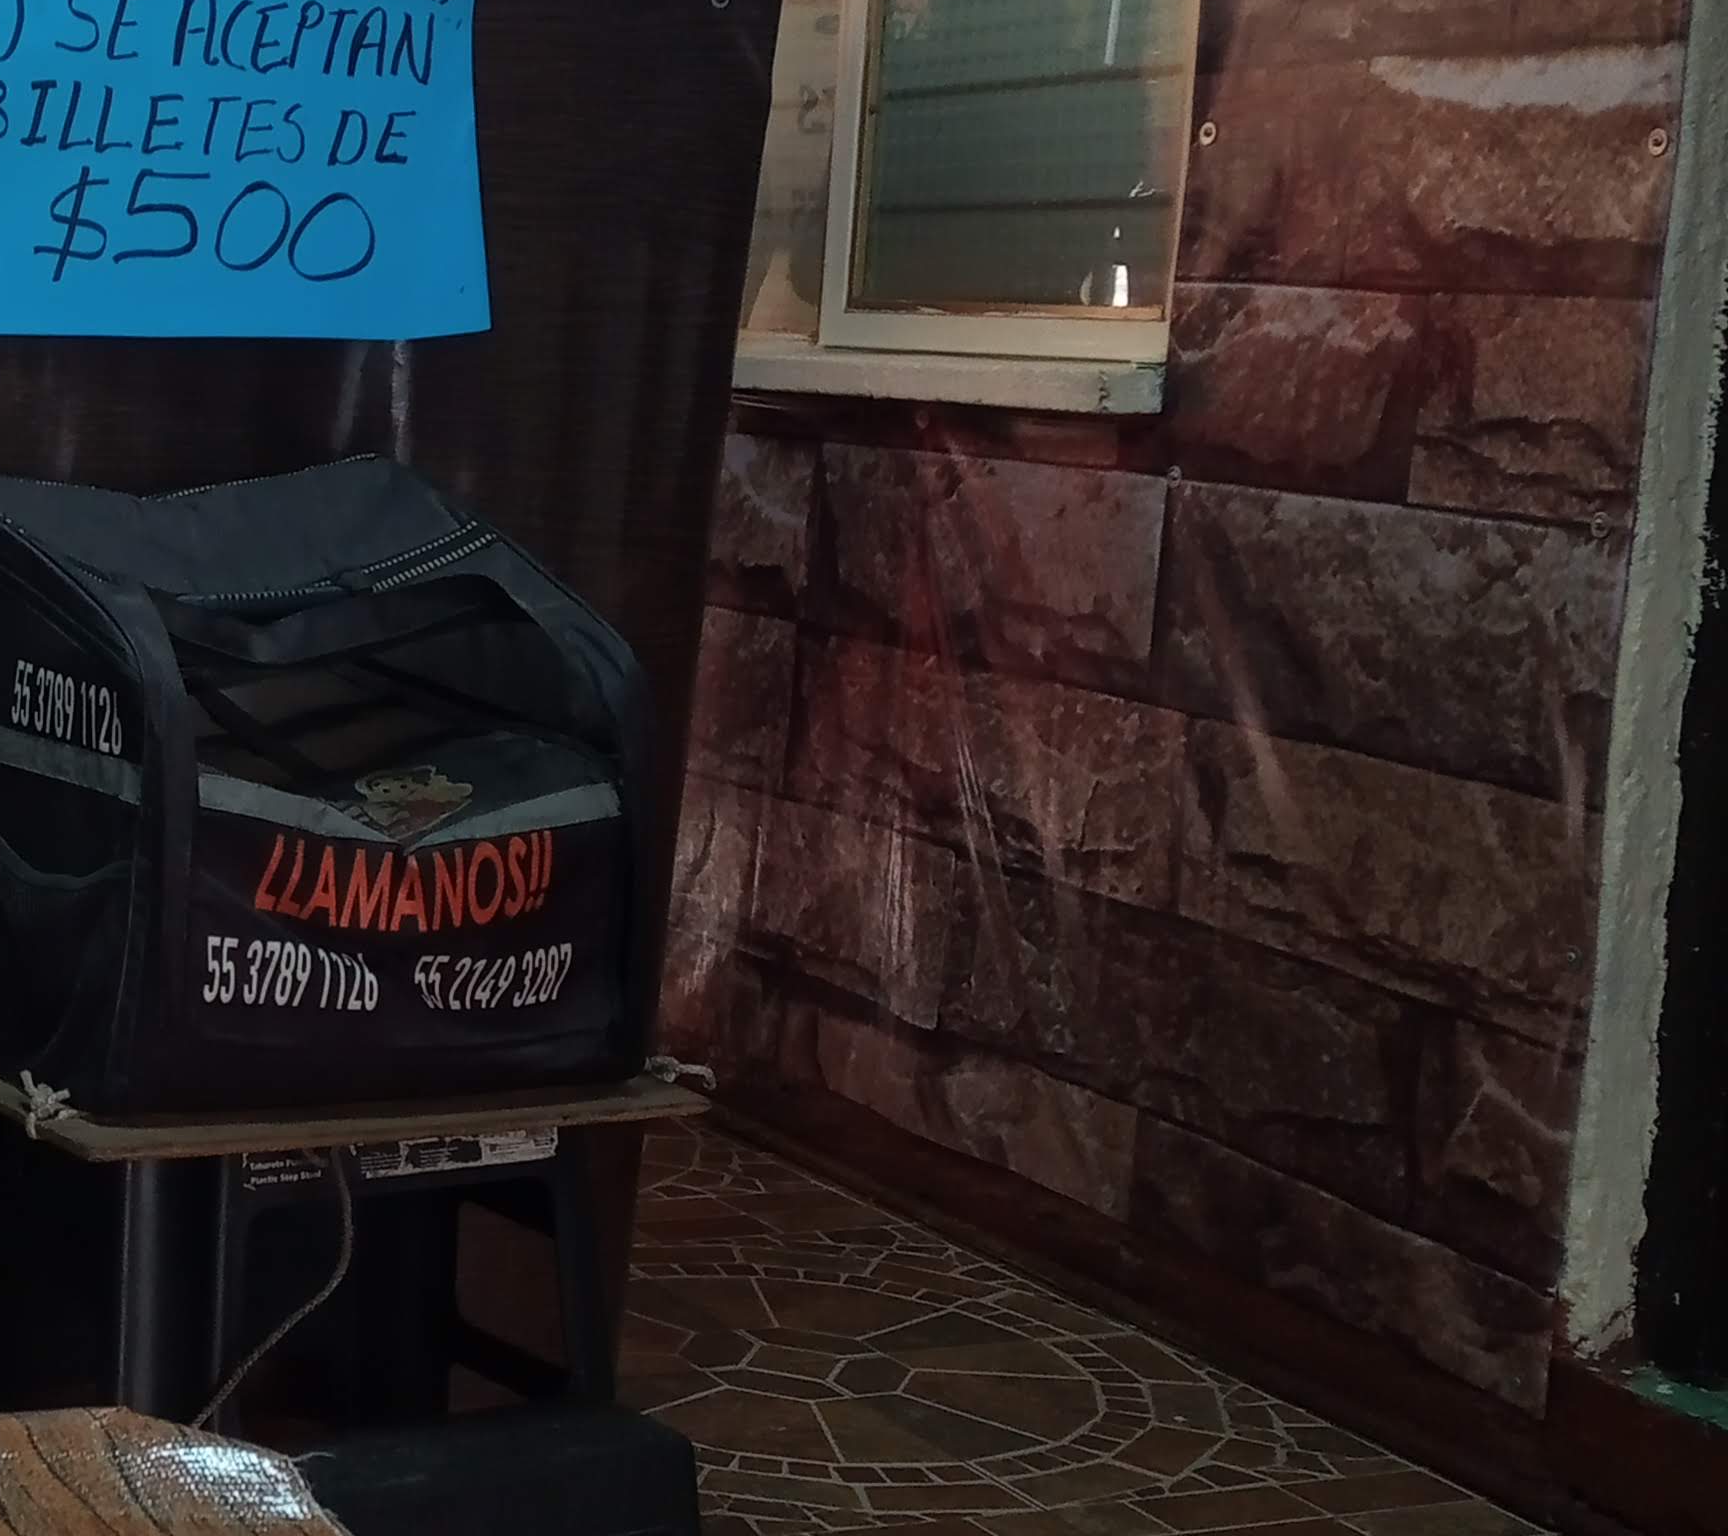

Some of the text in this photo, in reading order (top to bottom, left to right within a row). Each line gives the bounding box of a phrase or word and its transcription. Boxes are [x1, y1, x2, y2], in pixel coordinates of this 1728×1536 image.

[327, 109, 418, 166] DE
[32, 166, 377, 282] $500
[11, 659, 123, 756] 55 3789 1126
[254, 829, 554, 934] LLAMANOS!!
[202, 934, 380, 1012] 55 3789 1126
[413, 942, 573, 1011] 55 2149 3287
